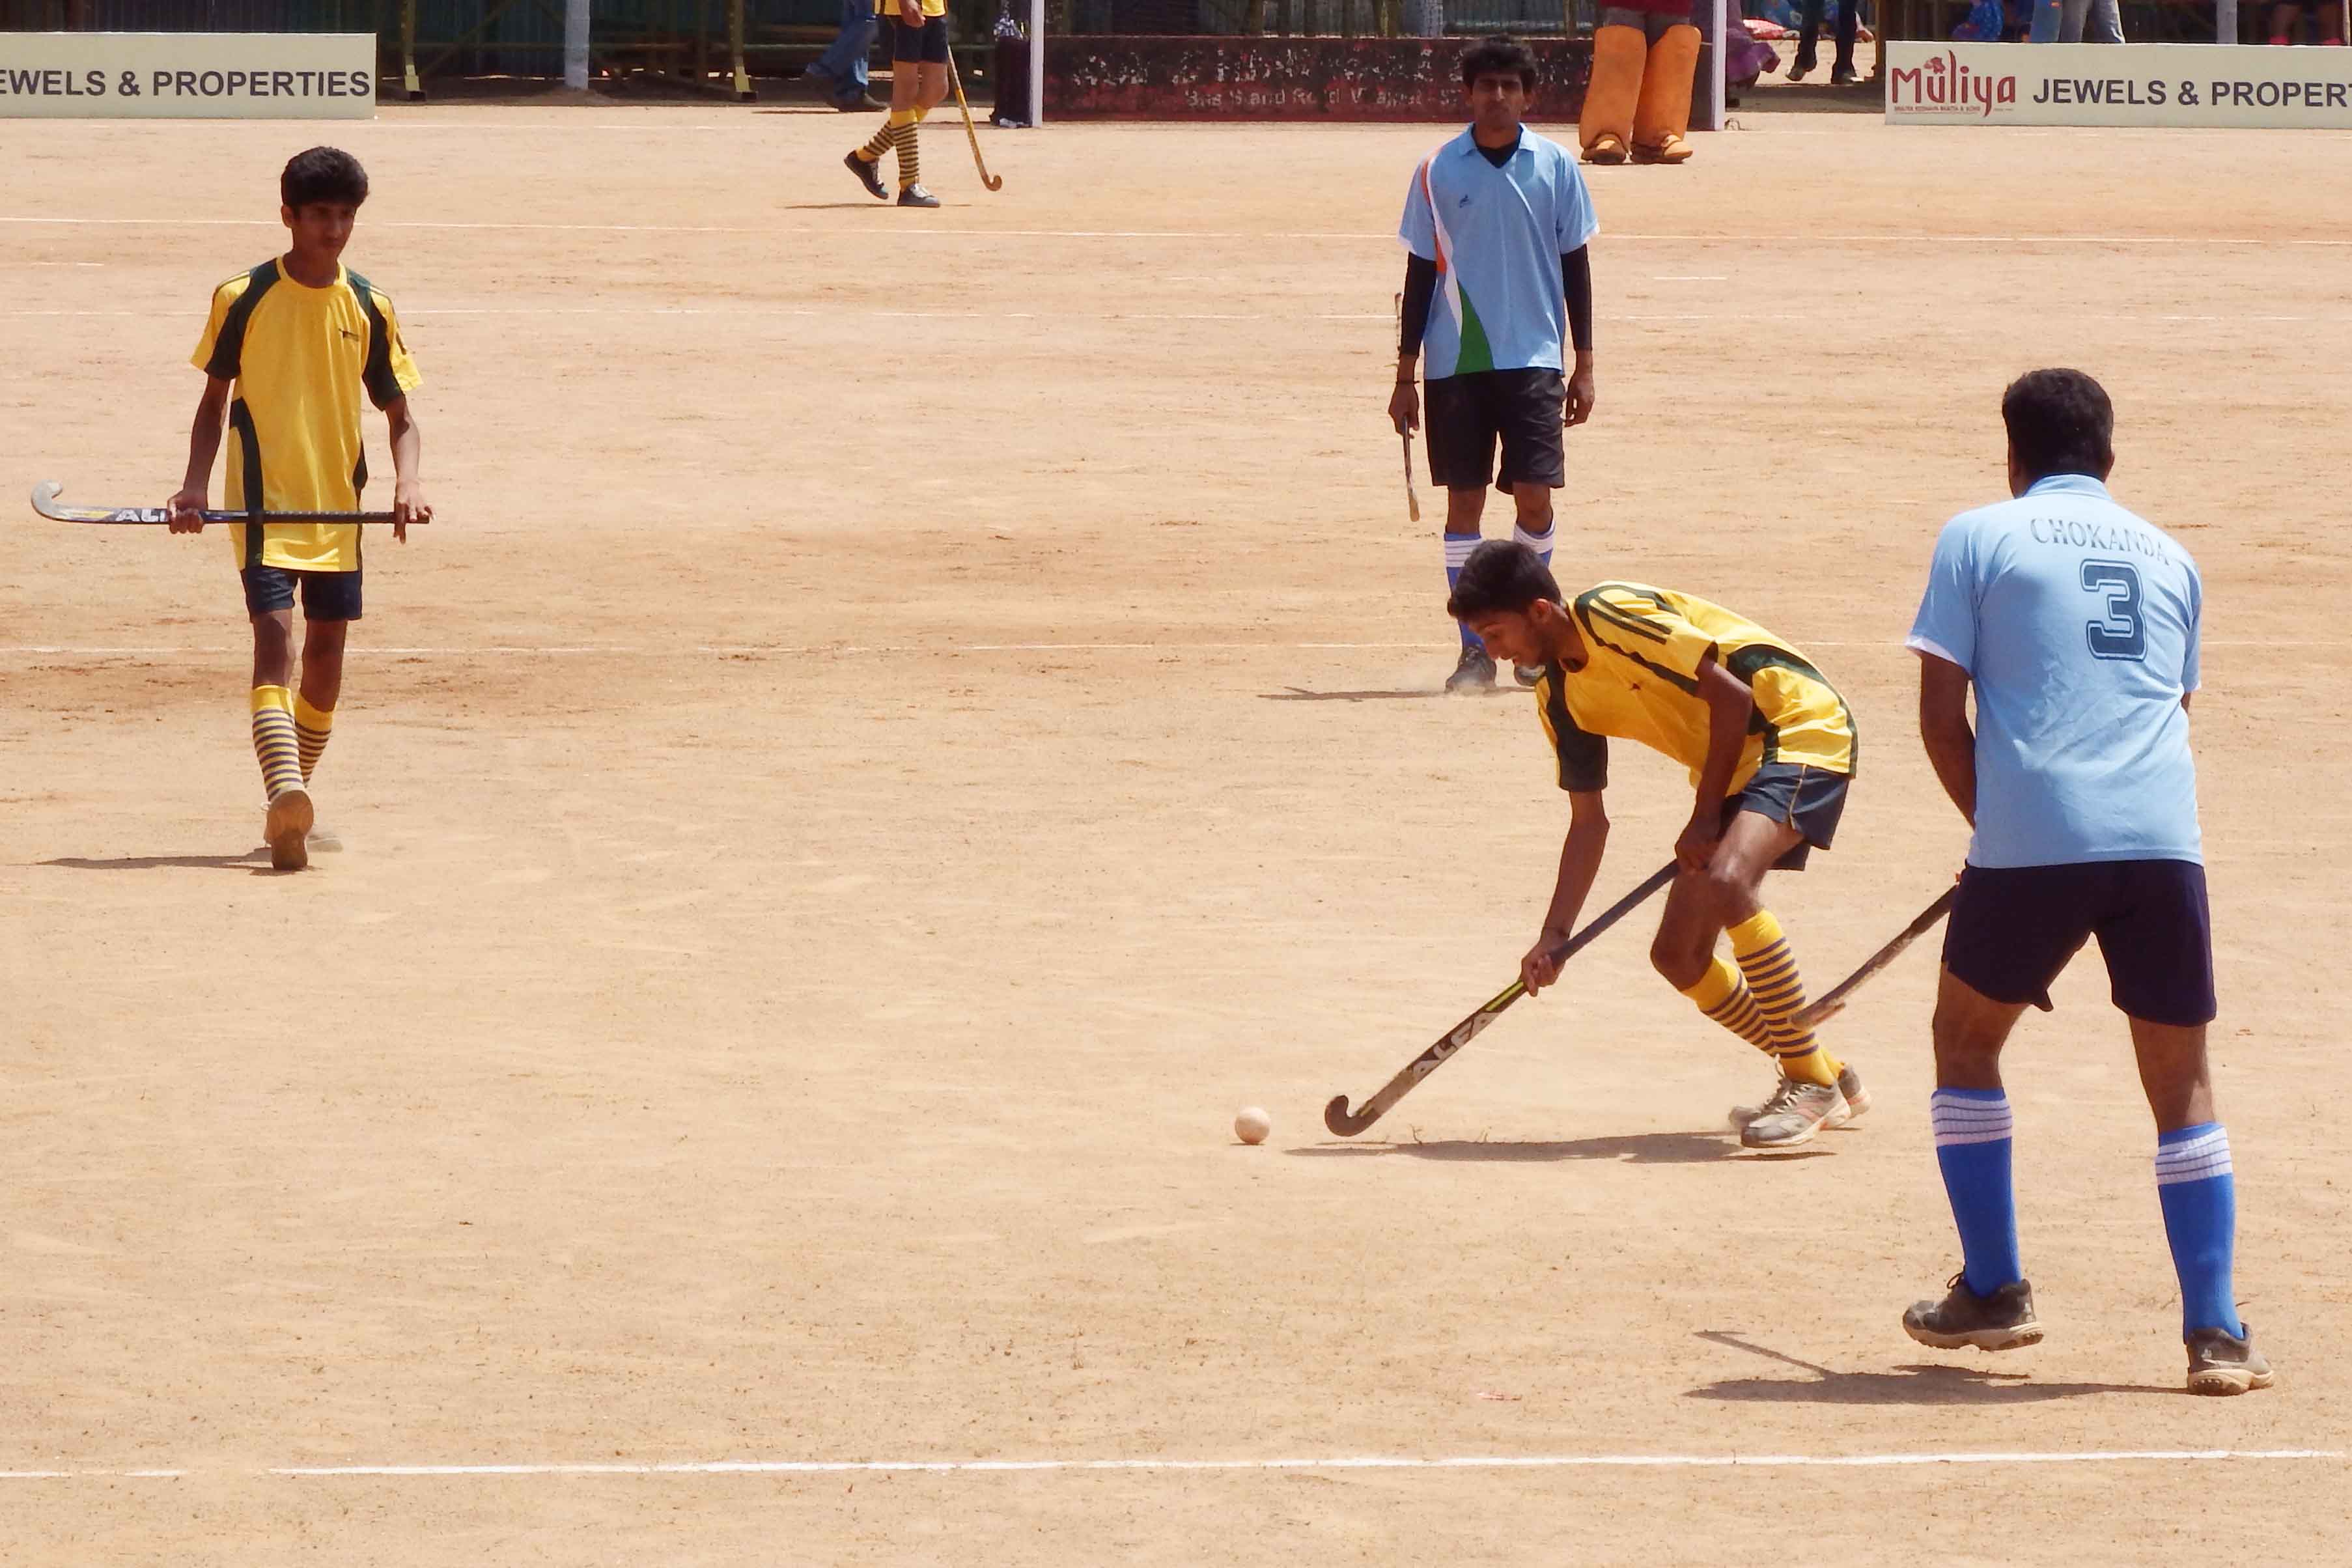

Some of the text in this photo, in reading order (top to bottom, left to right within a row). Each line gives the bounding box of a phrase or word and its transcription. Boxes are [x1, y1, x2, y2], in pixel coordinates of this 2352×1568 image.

[118, 71, 139, 96] &
[152, 71, 370, 97] PROPERTIES
[1892, 49, 2016, 117] Muliya
[2033, 79, 2352, 107] JEWELS & PROPER
[2030, 518, 2170, 567] CHOKANDA
[2080, 558, 2148, 662] 3
